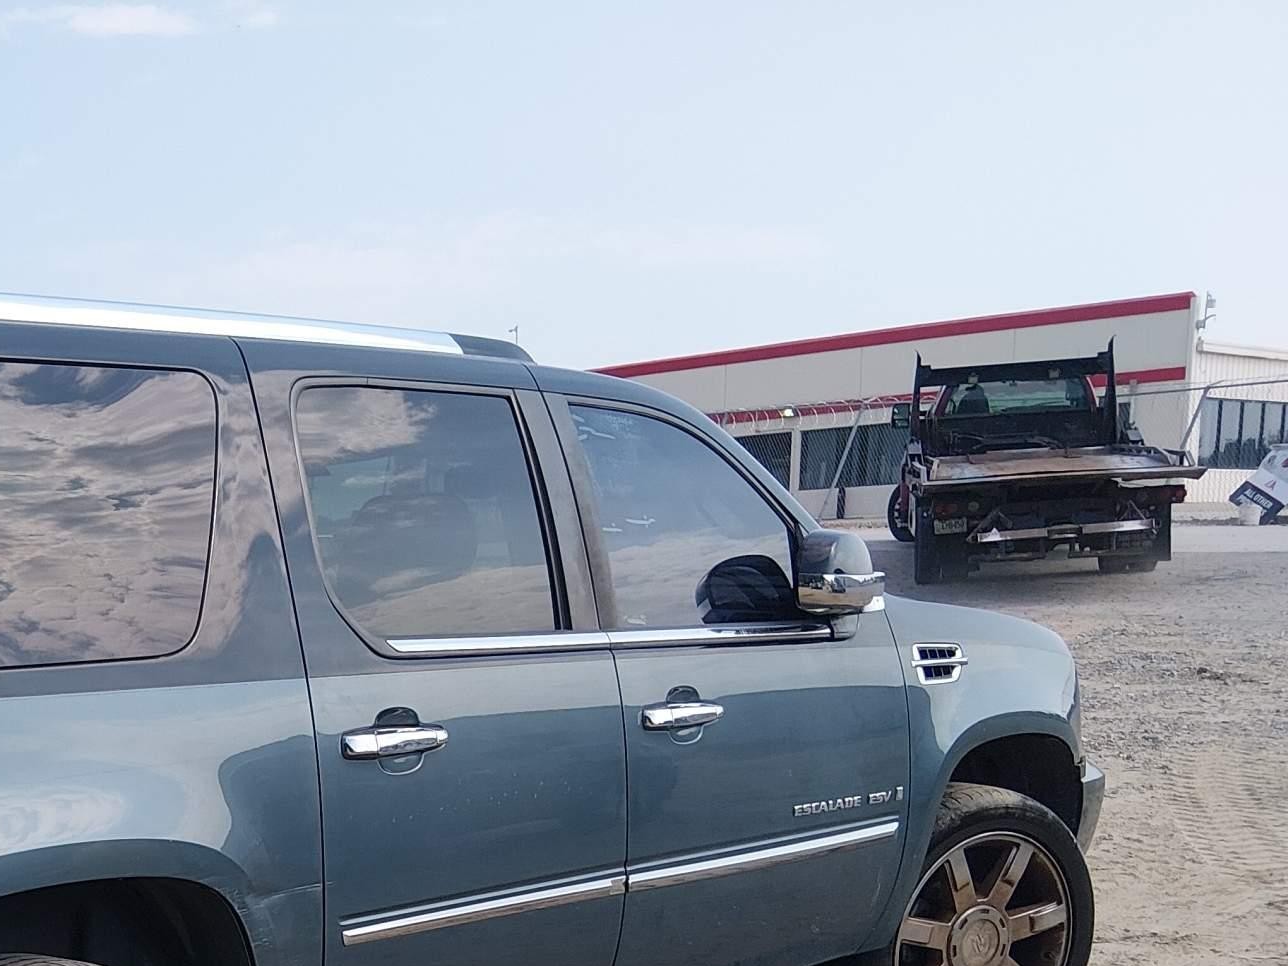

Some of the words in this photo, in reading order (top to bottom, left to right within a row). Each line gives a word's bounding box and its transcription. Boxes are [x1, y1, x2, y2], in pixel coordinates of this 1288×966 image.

[1253, 493, 1273, 509] OTHER
[794, 796, 862, 817] ESCALADE
[869, 791, 892, 805] ESV
